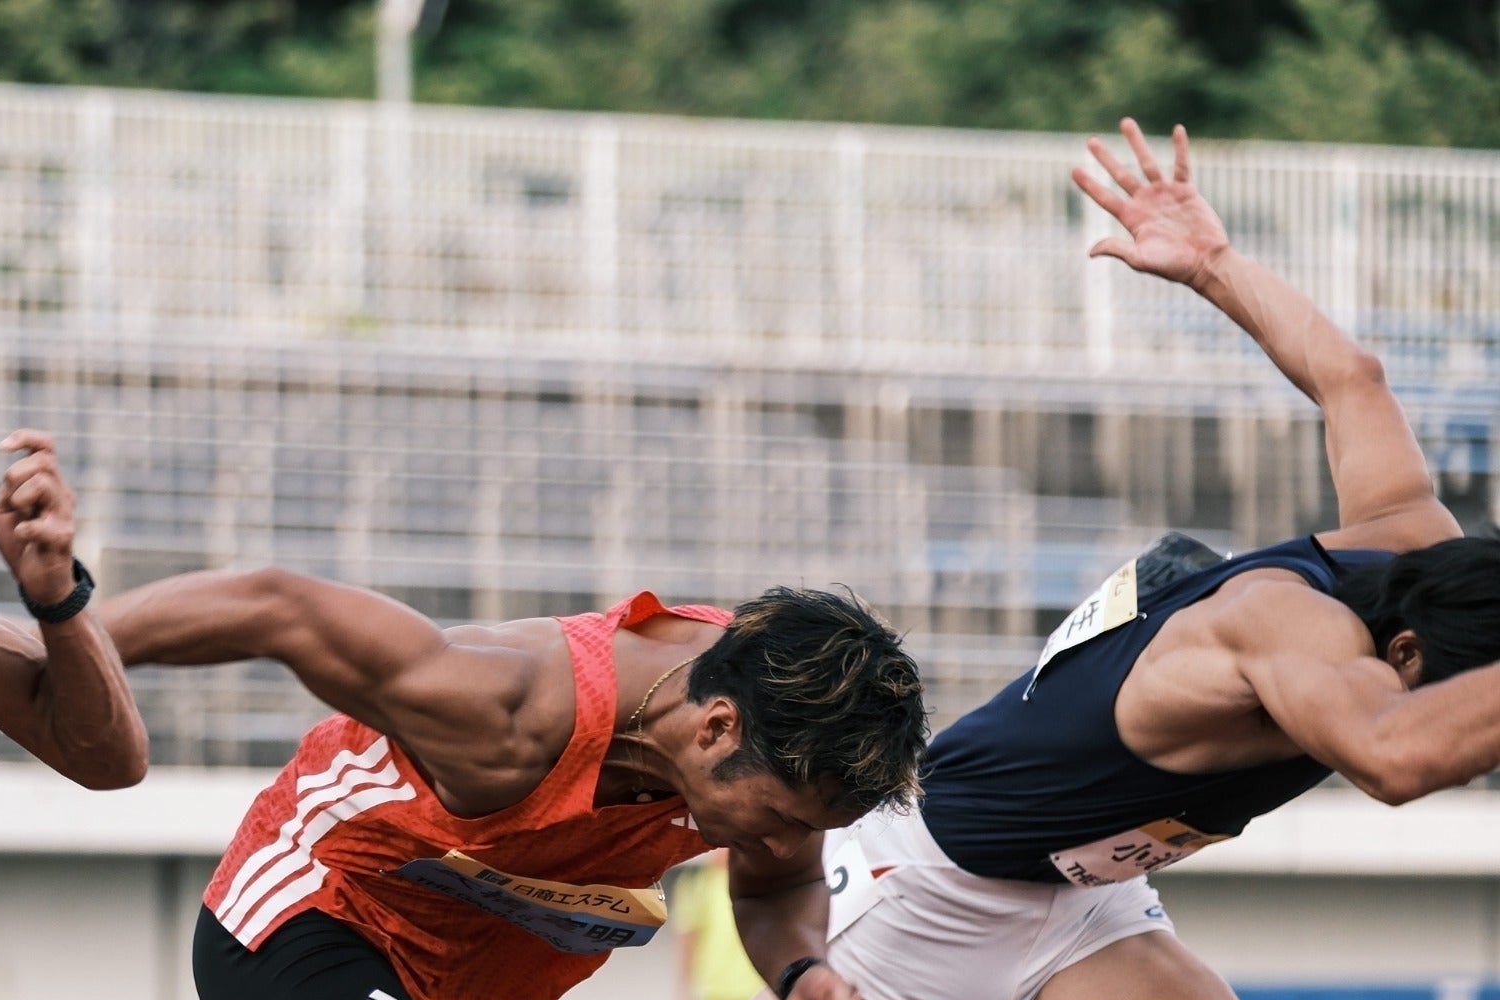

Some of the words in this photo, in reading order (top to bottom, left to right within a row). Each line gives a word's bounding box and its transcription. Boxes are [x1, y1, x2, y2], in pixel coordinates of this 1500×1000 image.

[513, 884, 630, 914] 日商エステム
